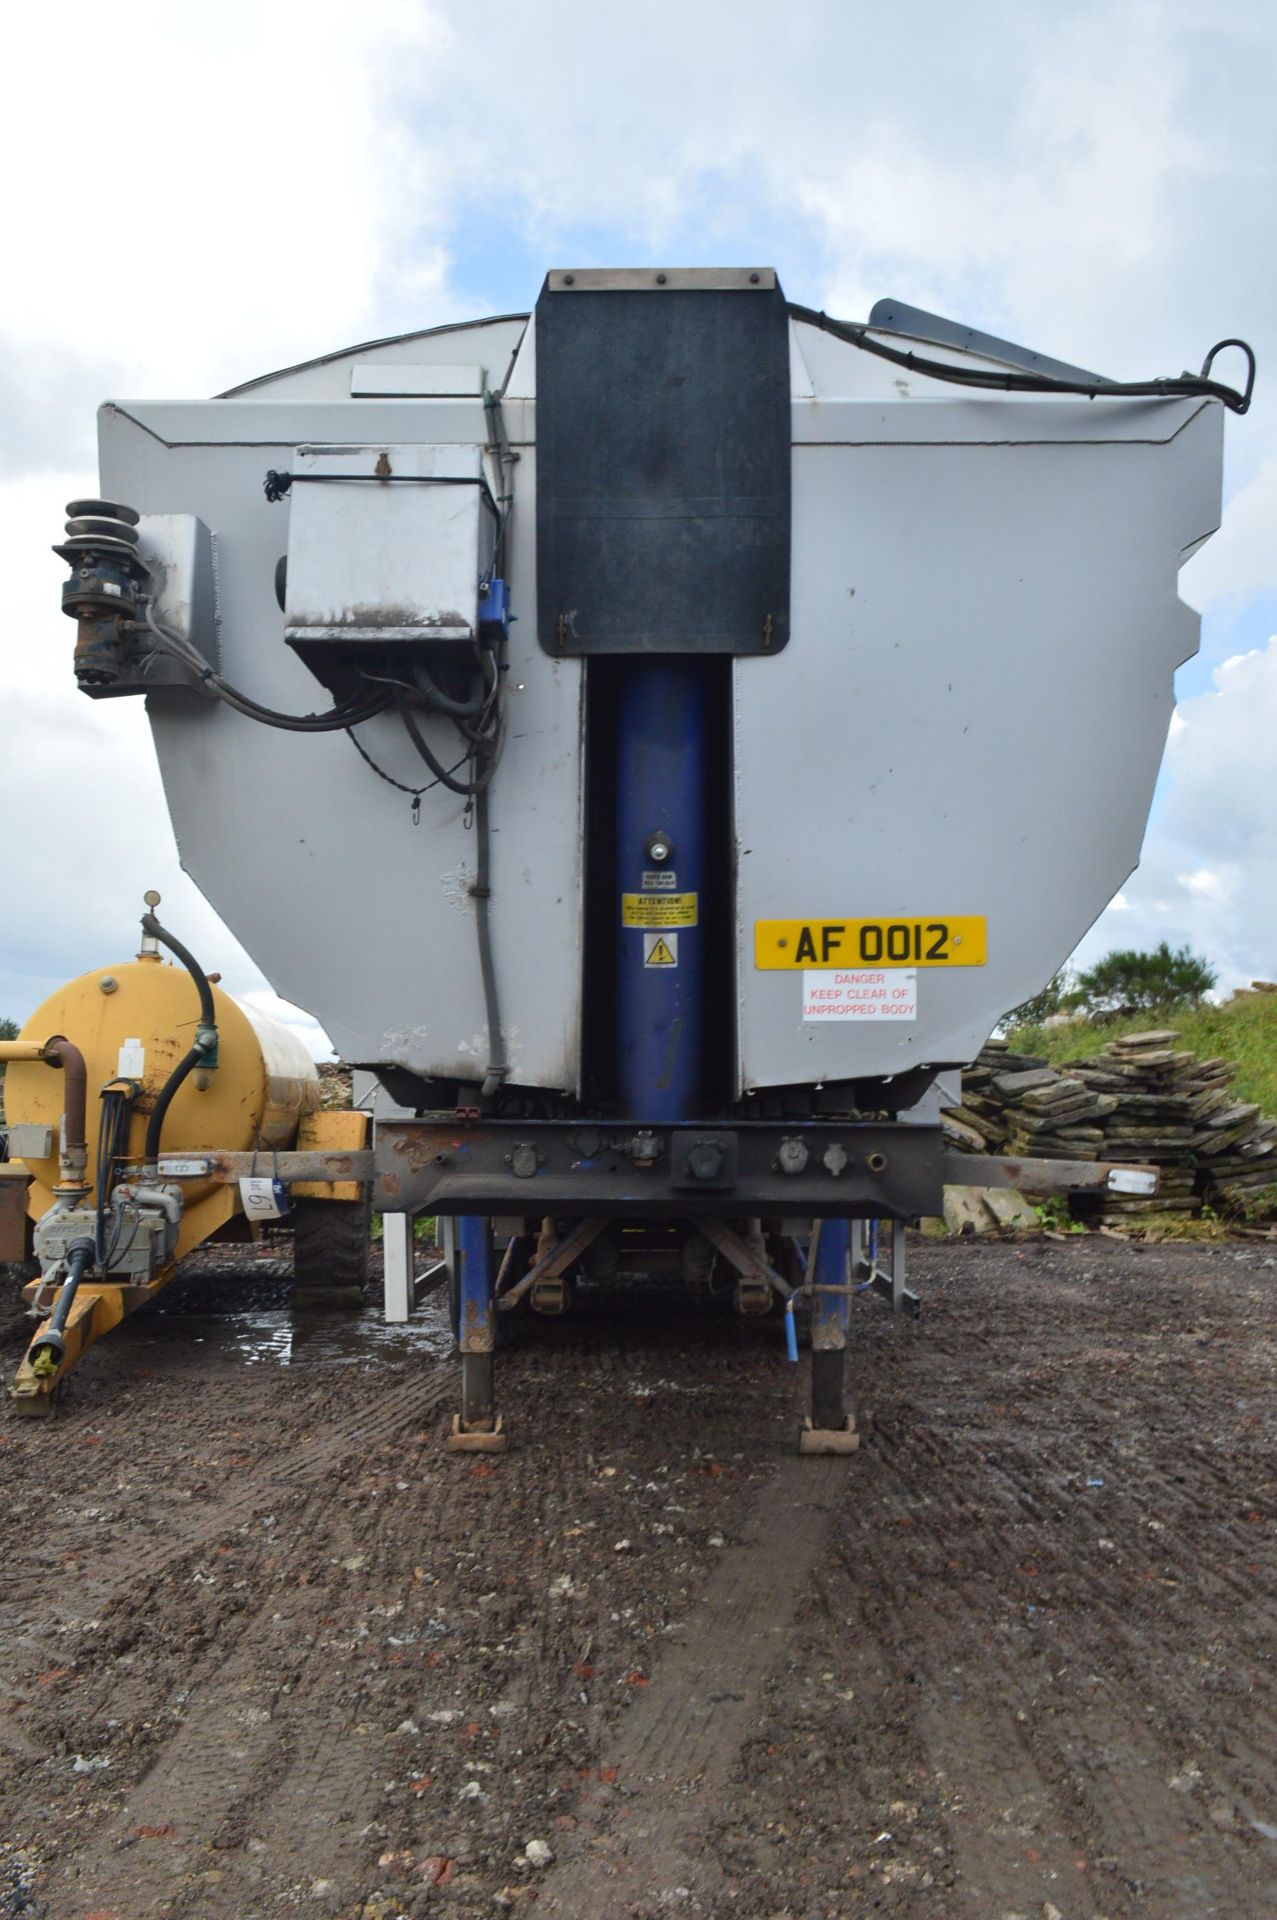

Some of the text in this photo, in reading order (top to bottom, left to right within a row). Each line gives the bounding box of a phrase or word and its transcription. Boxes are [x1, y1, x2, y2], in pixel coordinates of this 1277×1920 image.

[794, 924, 949, 963] AF 0012
[834, 974, 885, 984] DANGER
[811, 989, 909, 999] KEEP CLEAR OF
[804, 1004, 915, 1015] UNPROPPED BODY
